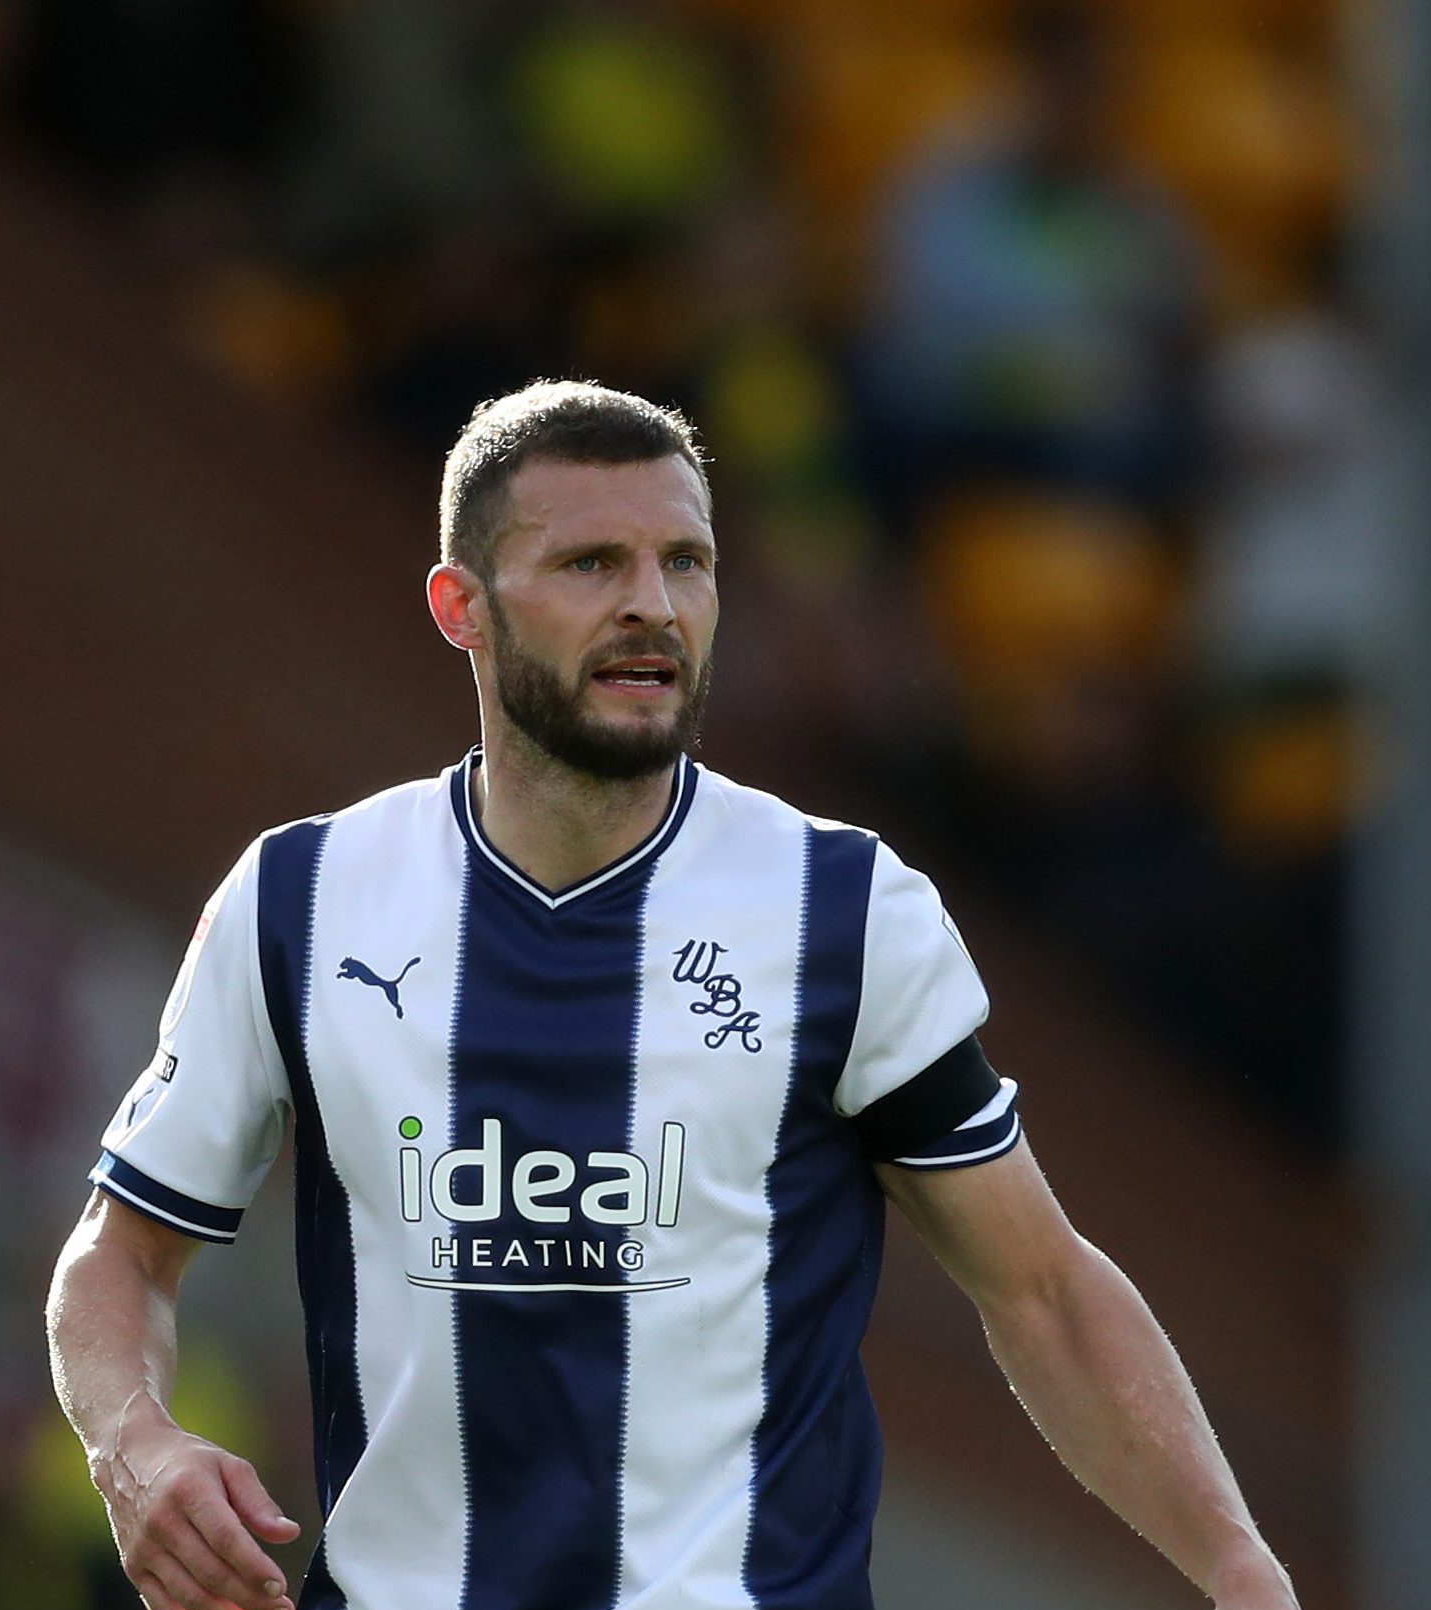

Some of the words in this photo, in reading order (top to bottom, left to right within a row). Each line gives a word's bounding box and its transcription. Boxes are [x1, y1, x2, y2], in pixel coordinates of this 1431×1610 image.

[672, 939, 762, 1053] WBA
[399, 1116, 685, 1227] ideal
[431, 1238, 644, 1271] HEATING
